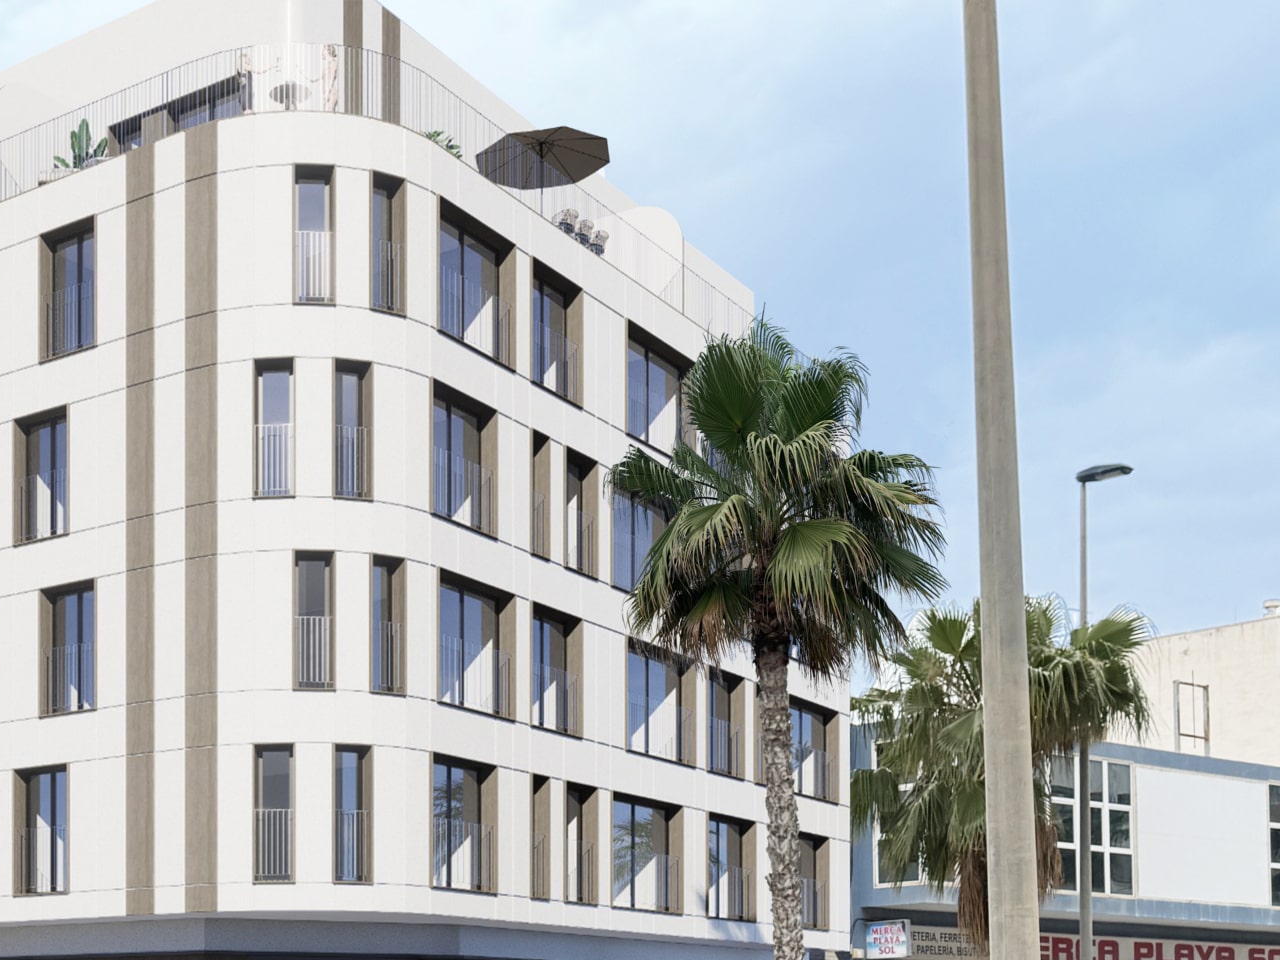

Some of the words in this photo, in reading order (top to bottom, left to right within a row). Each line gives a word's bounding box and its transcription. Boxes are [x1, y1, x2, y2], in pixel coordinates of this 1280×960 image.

[872, 925, 903, 936] MERCA
[873, 936, 901, 946] PLAYA
[910, 931, 938, 943] ETERIA,
[940, 932, 971, 944] FERRETE
[878, 946, 895, 955] SOL
